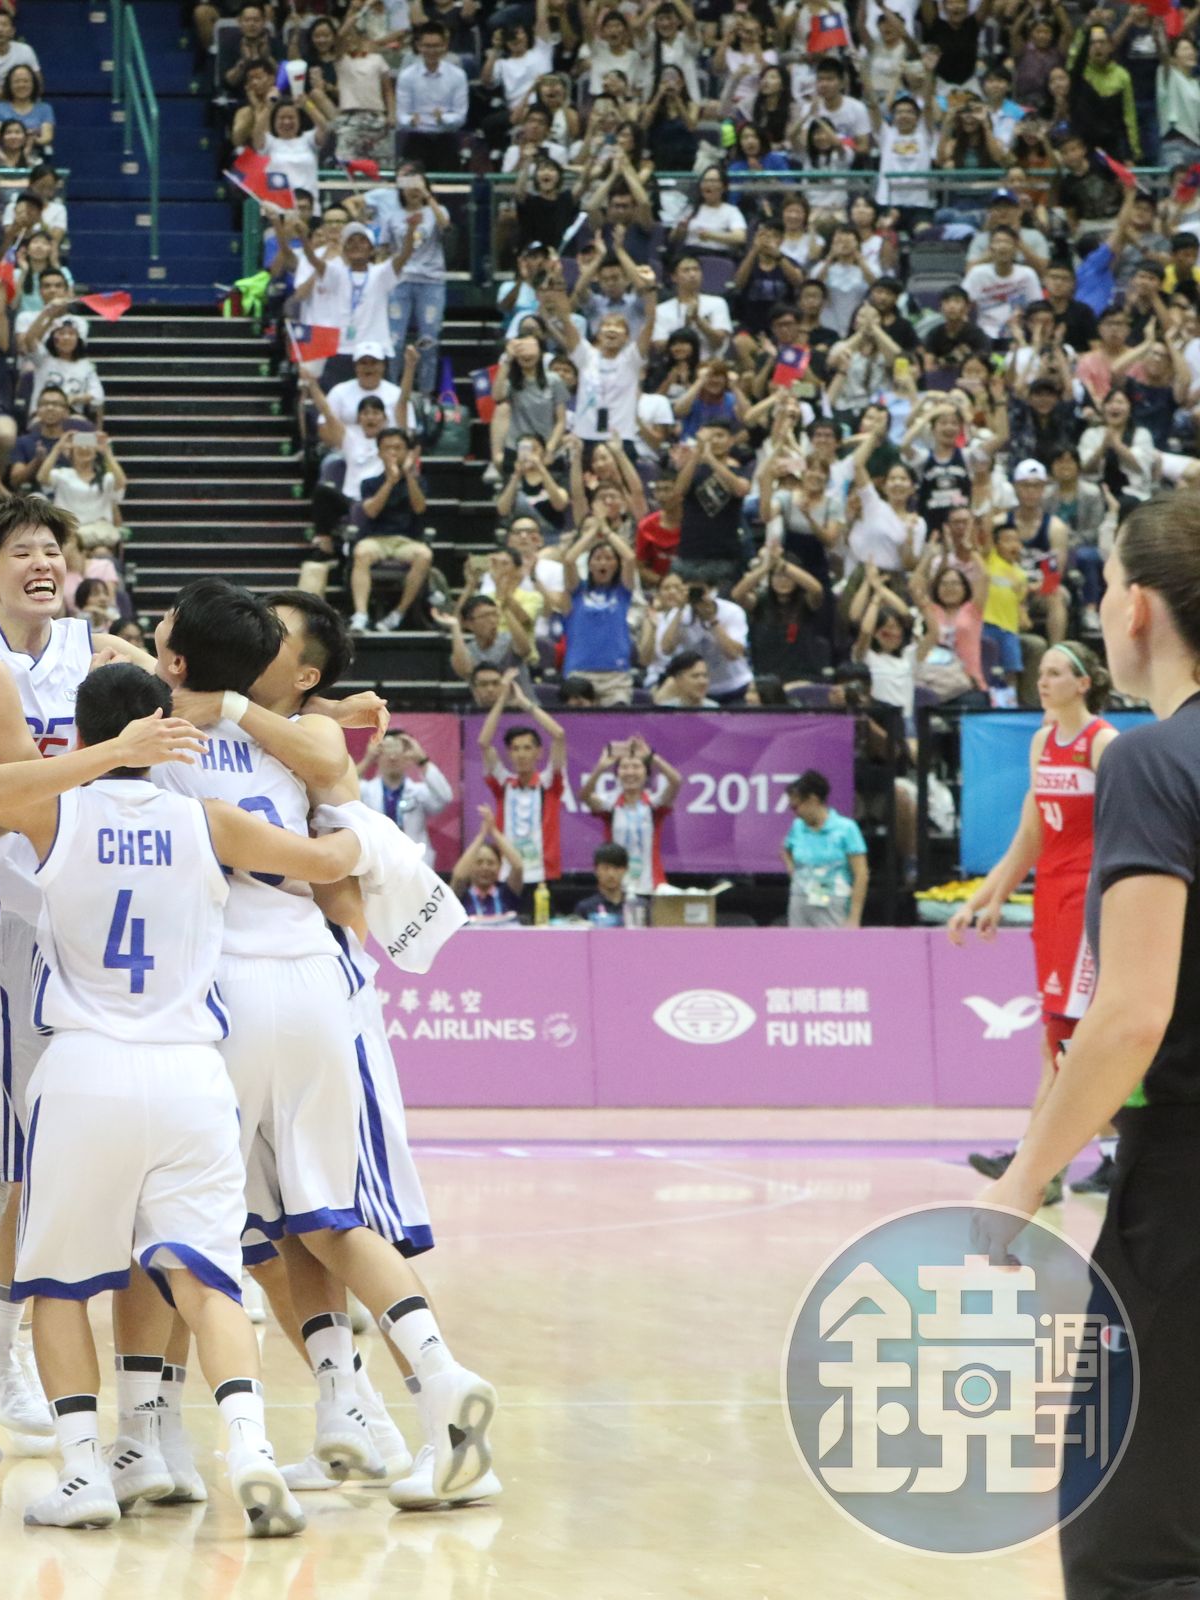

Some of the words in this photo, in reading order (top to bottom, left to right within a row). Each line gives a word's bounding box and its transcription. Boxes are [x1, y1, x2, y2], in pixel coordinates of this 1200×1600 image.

[686, 772, 801, 814] 2017
[97, 827, 172, 866] CHEN
[419, 885, 445, 923] 2017
[103, 889, 155, 994] 4
[412, 1018, 537, 1041] AIRLINES
[766, 1020, 798, 1046] FU
[804, 1020, 873, 1046] HSUN
